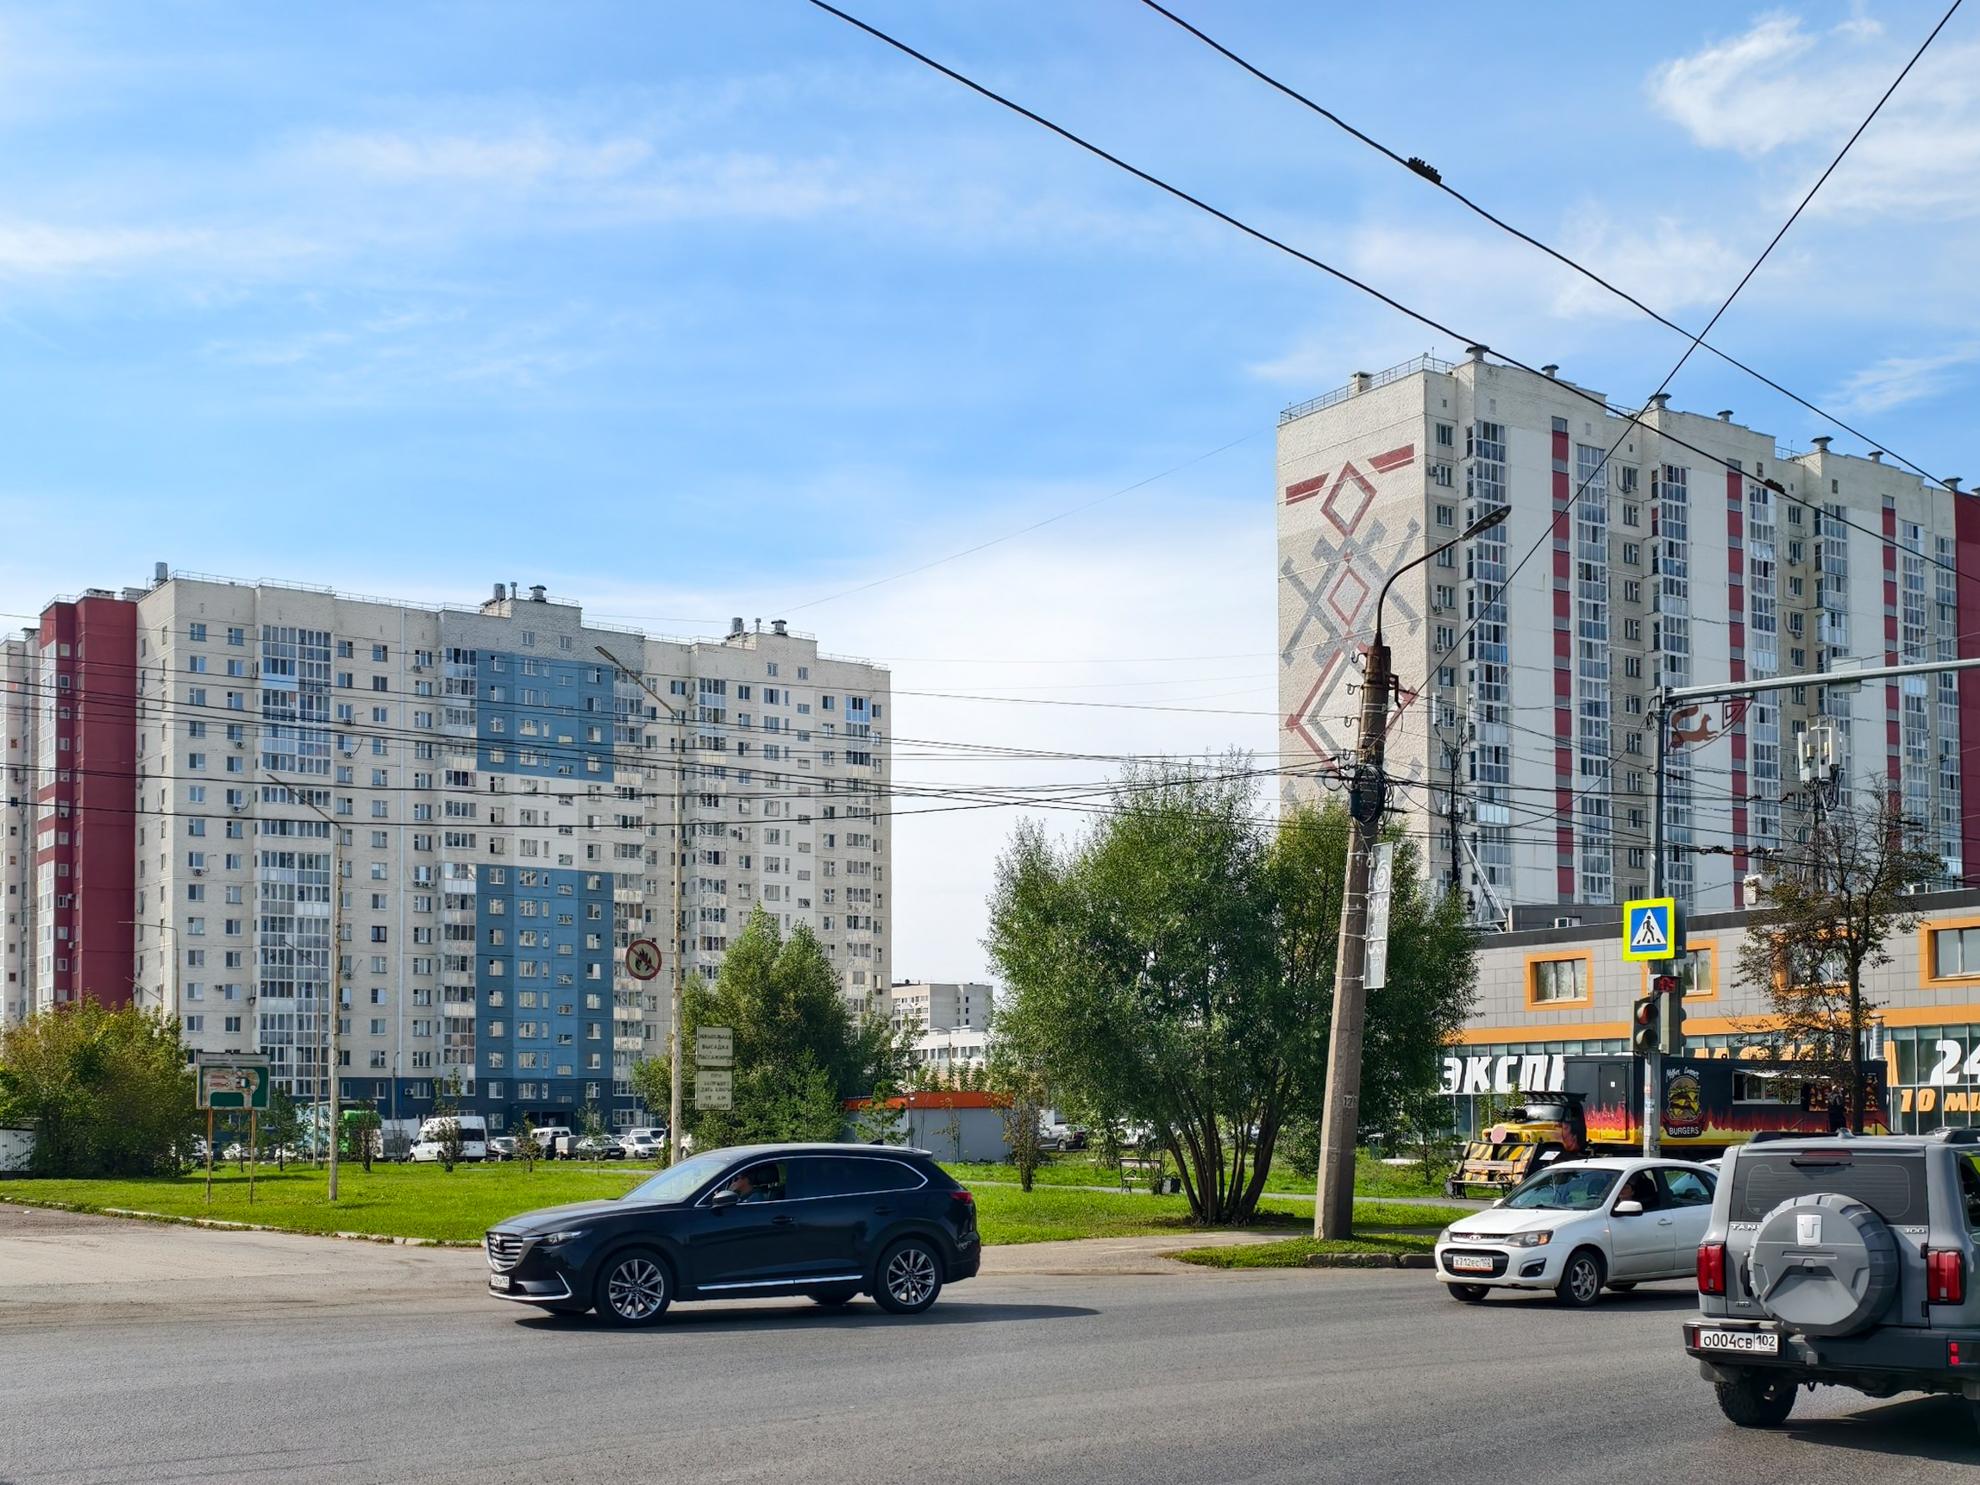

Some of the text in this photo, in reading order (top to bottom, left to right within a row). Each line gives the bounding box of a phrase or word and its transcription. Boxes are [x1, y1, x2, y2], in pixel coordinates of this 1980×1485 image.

[1439, 1053, 1576, 1093] ЭКСП
[1901, 1088, 1936, 1112] 10
[1669, 1126, 1700, 1136] BURGERS
[1756, 1334, 1775, 1346] 102
